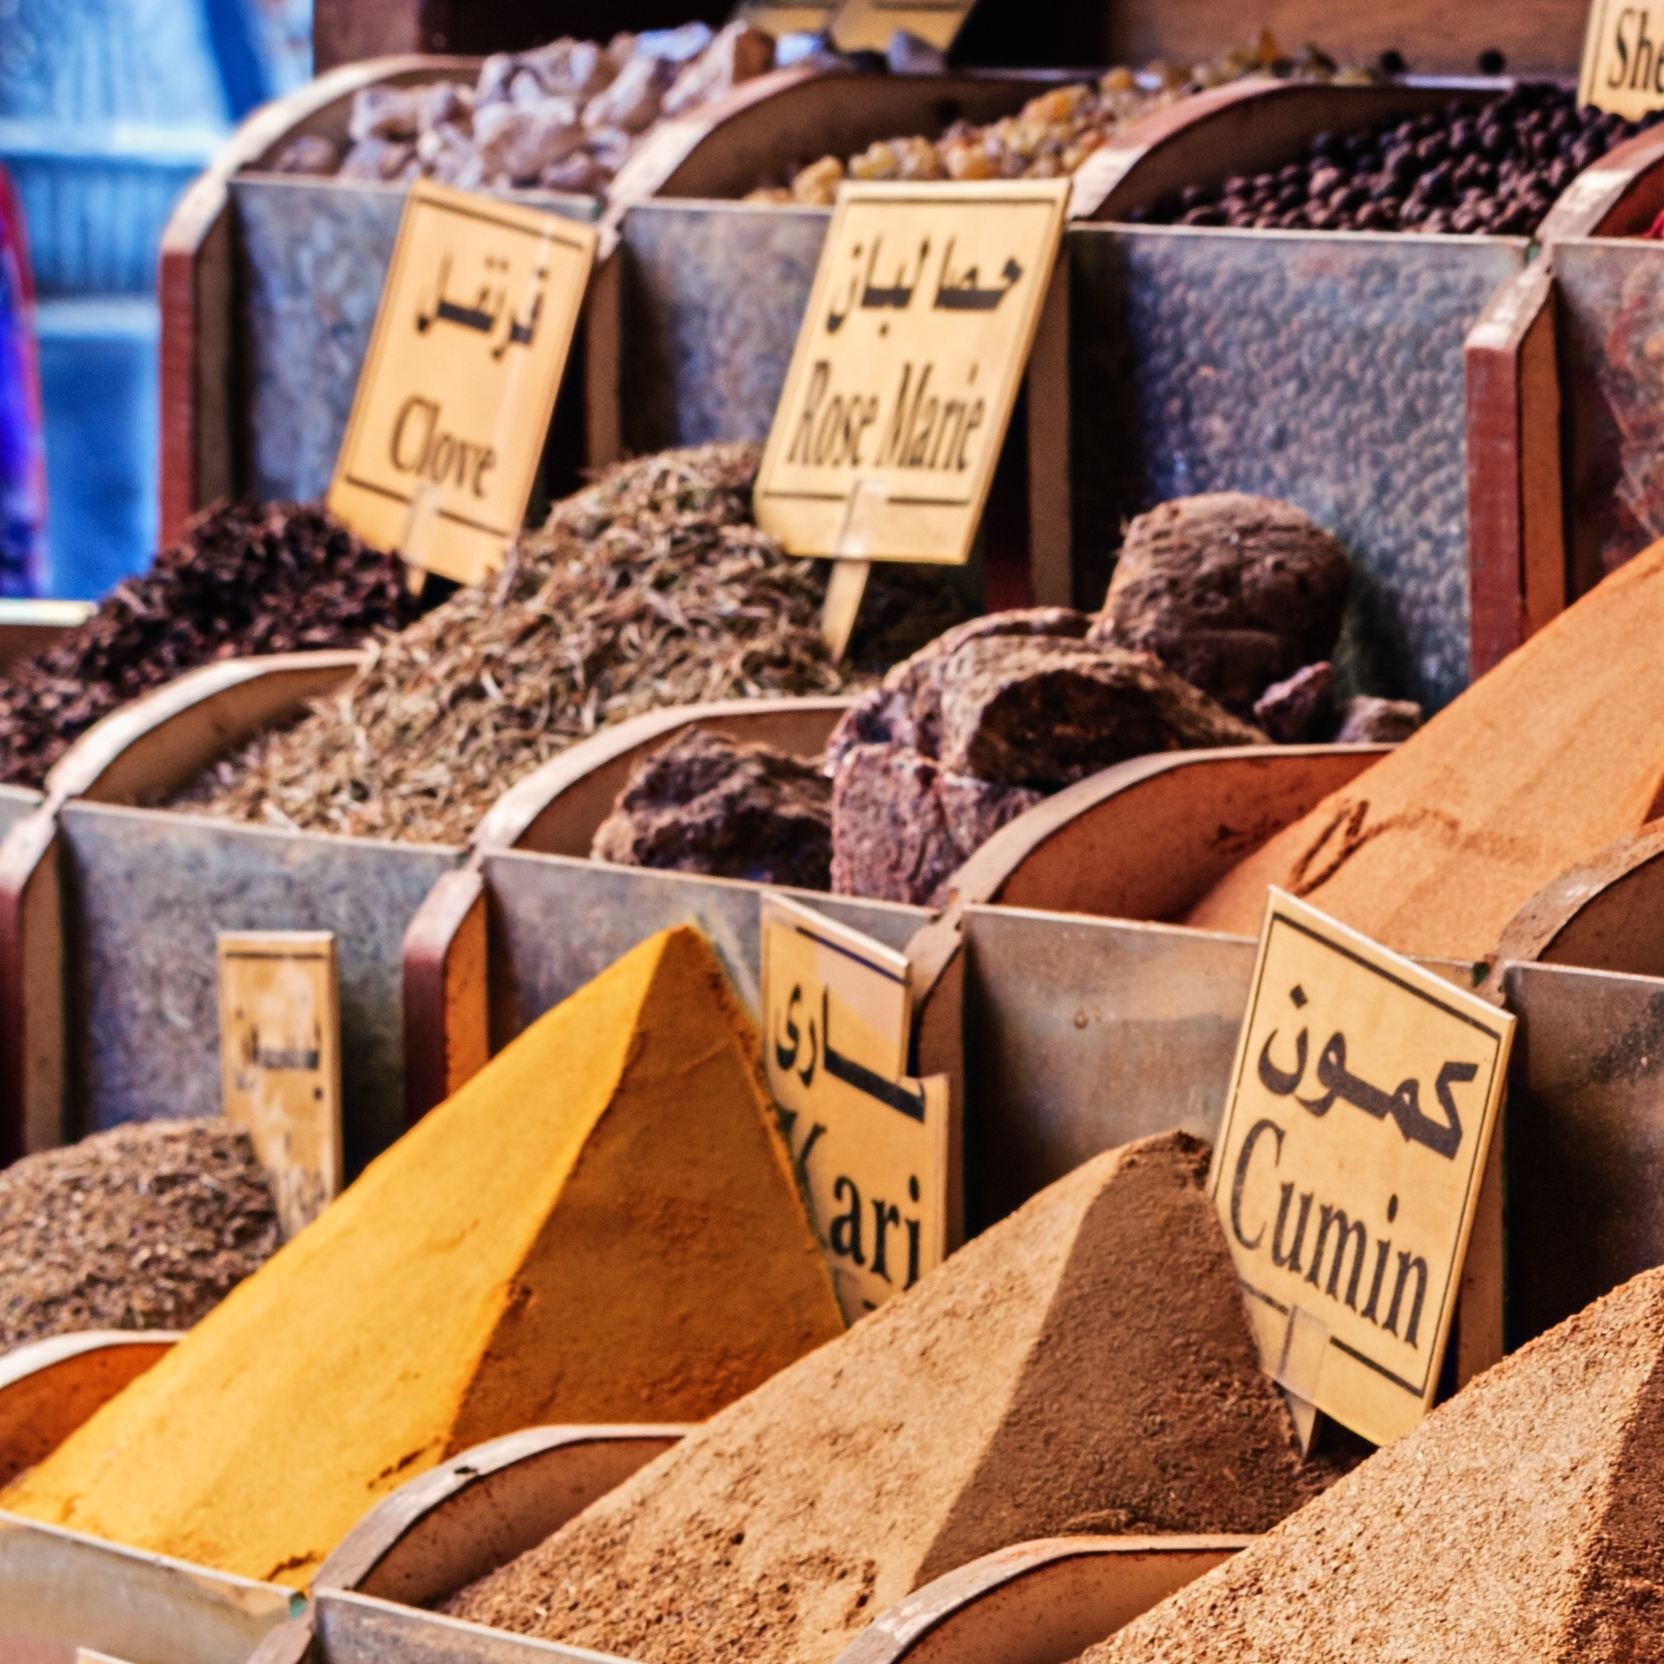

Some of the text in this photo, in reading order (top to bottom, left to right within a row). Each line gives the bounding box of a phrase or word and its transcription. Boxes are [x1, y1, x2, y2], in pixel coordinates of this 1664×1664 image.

[390, 394, 497, 497] Clove
[787, 361, 987, 472] Rose Marie
[1257, 983, 1479, 1160] كمون
[1230, 1119, 1428, 1351] Cumin
